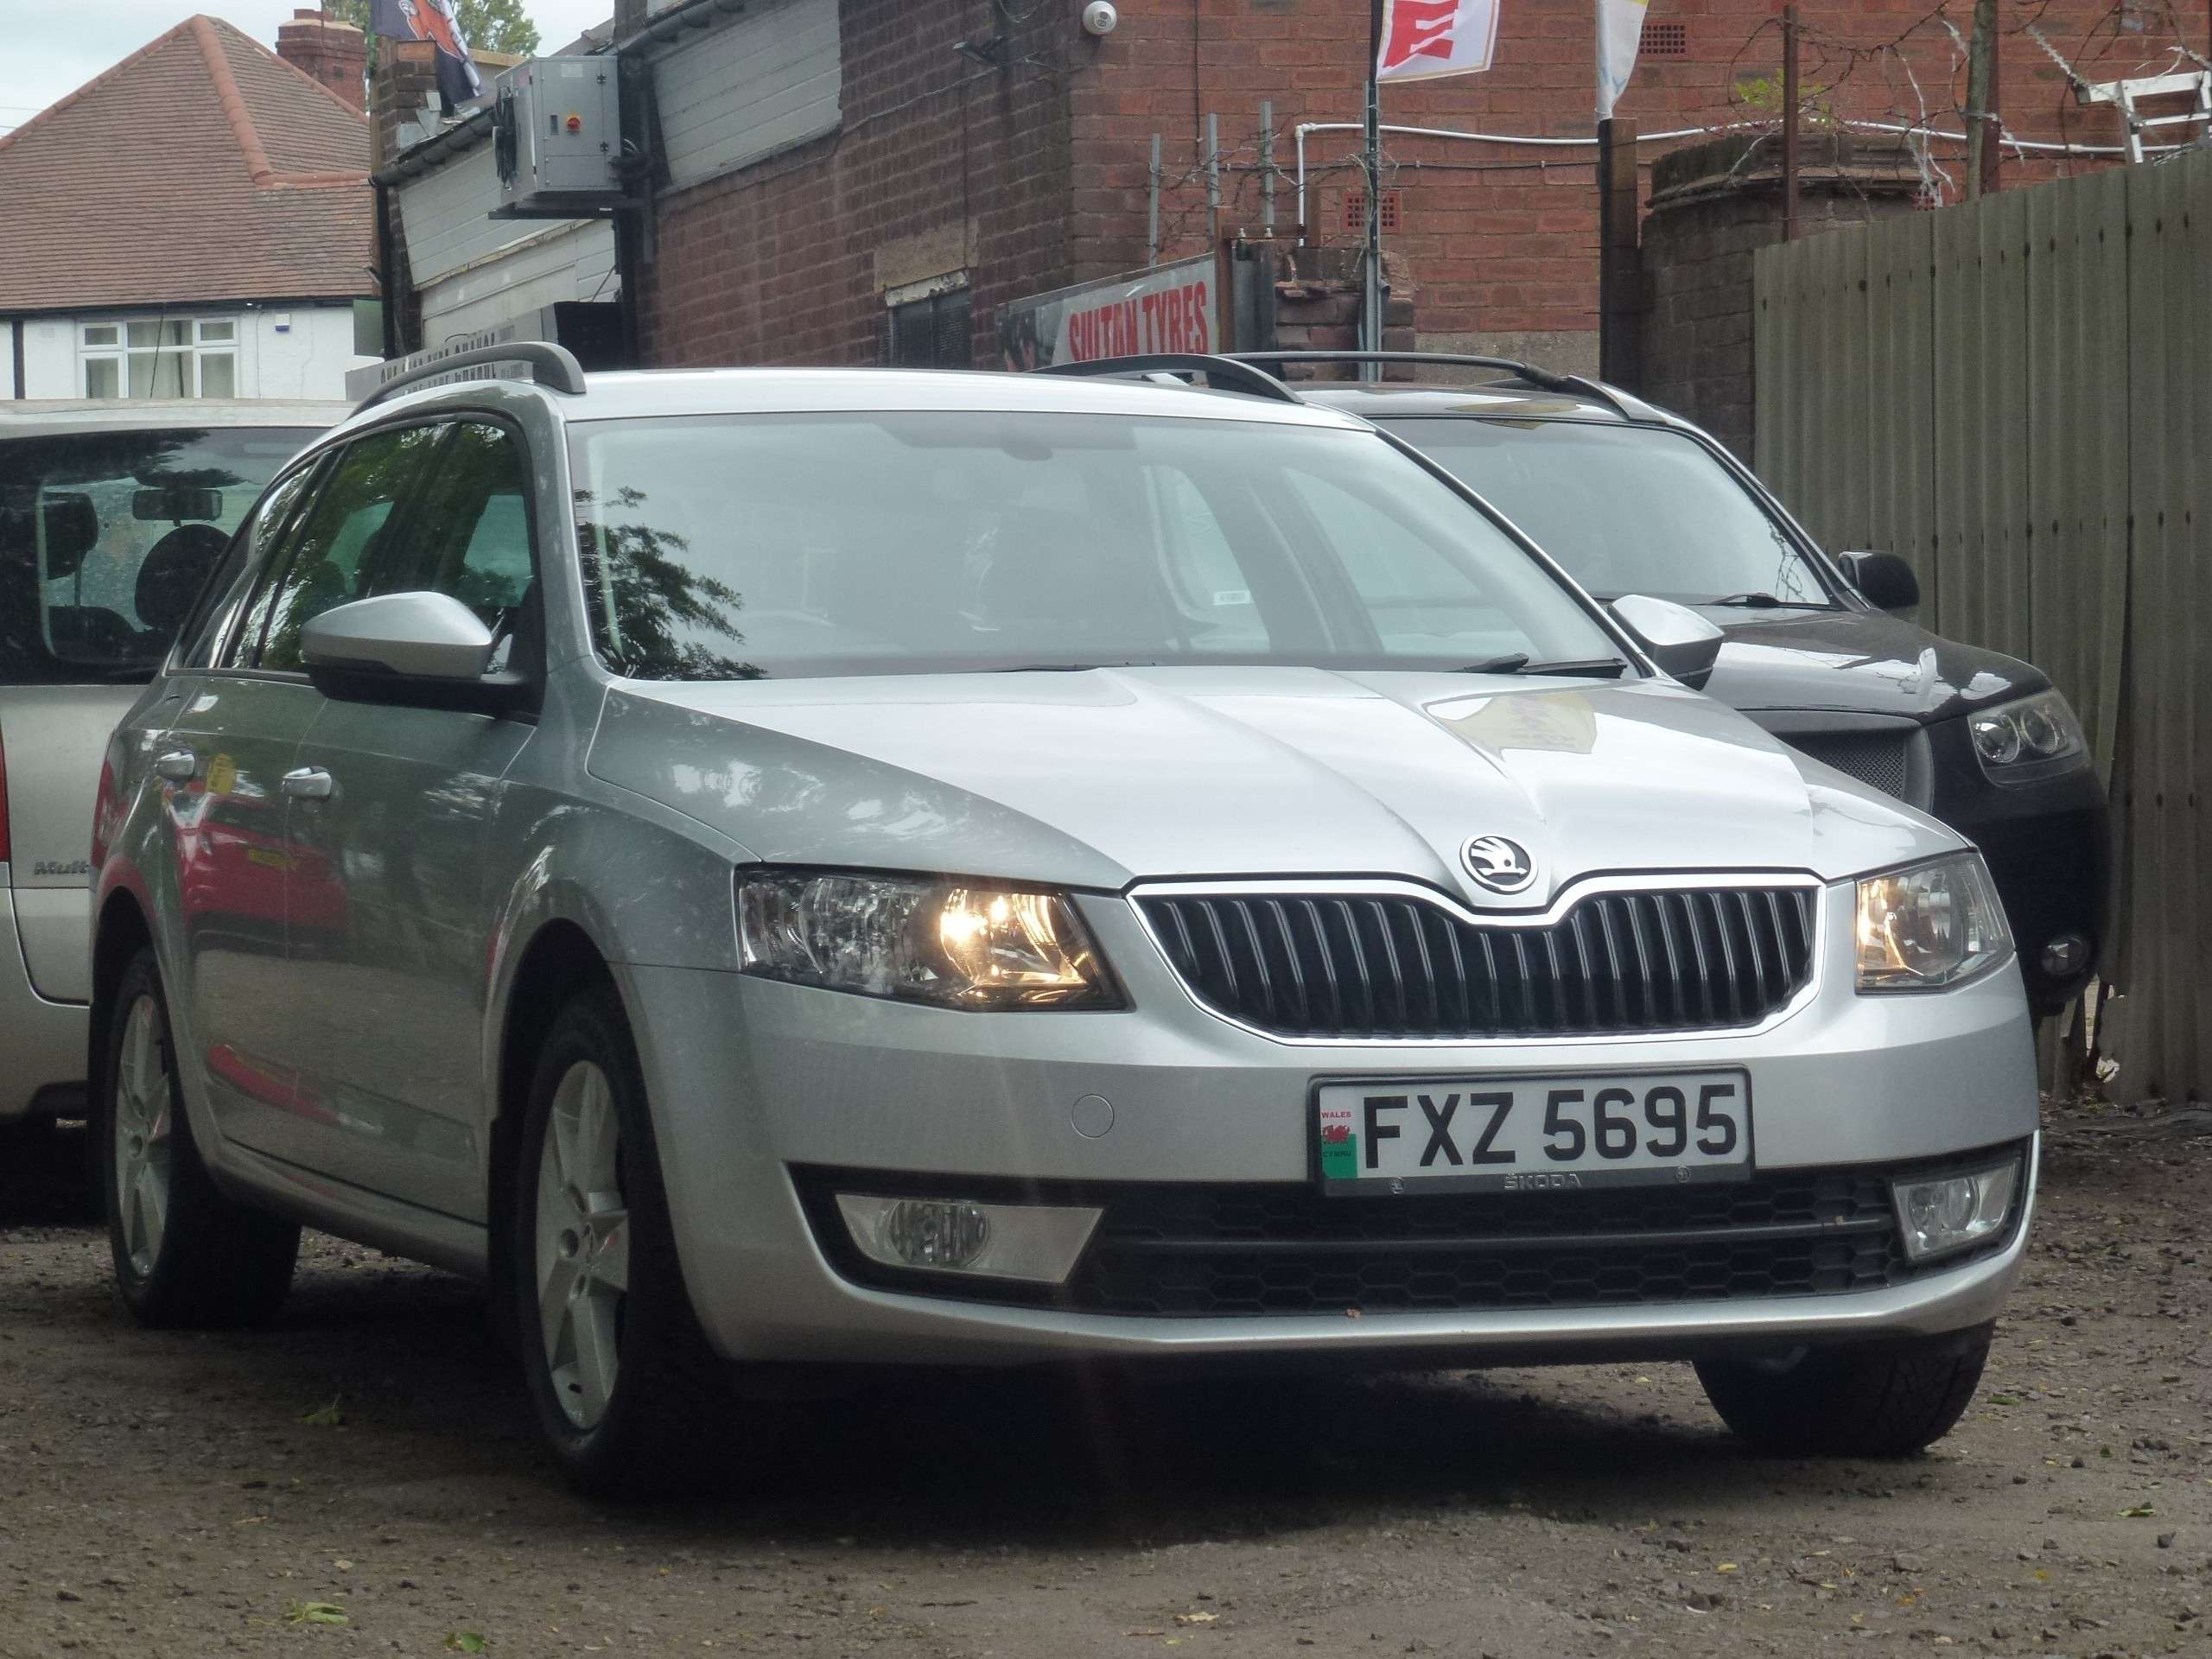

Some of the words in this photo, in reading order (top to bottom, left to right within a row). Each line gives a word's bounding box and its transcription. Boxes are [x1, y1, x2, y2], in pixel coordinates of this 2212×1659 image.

[1142, 281, 1209, 355] TYRES
[1363, 1091, 1516, 1169] FXZ
[1542, 1084, 1738, 1161] 5695
